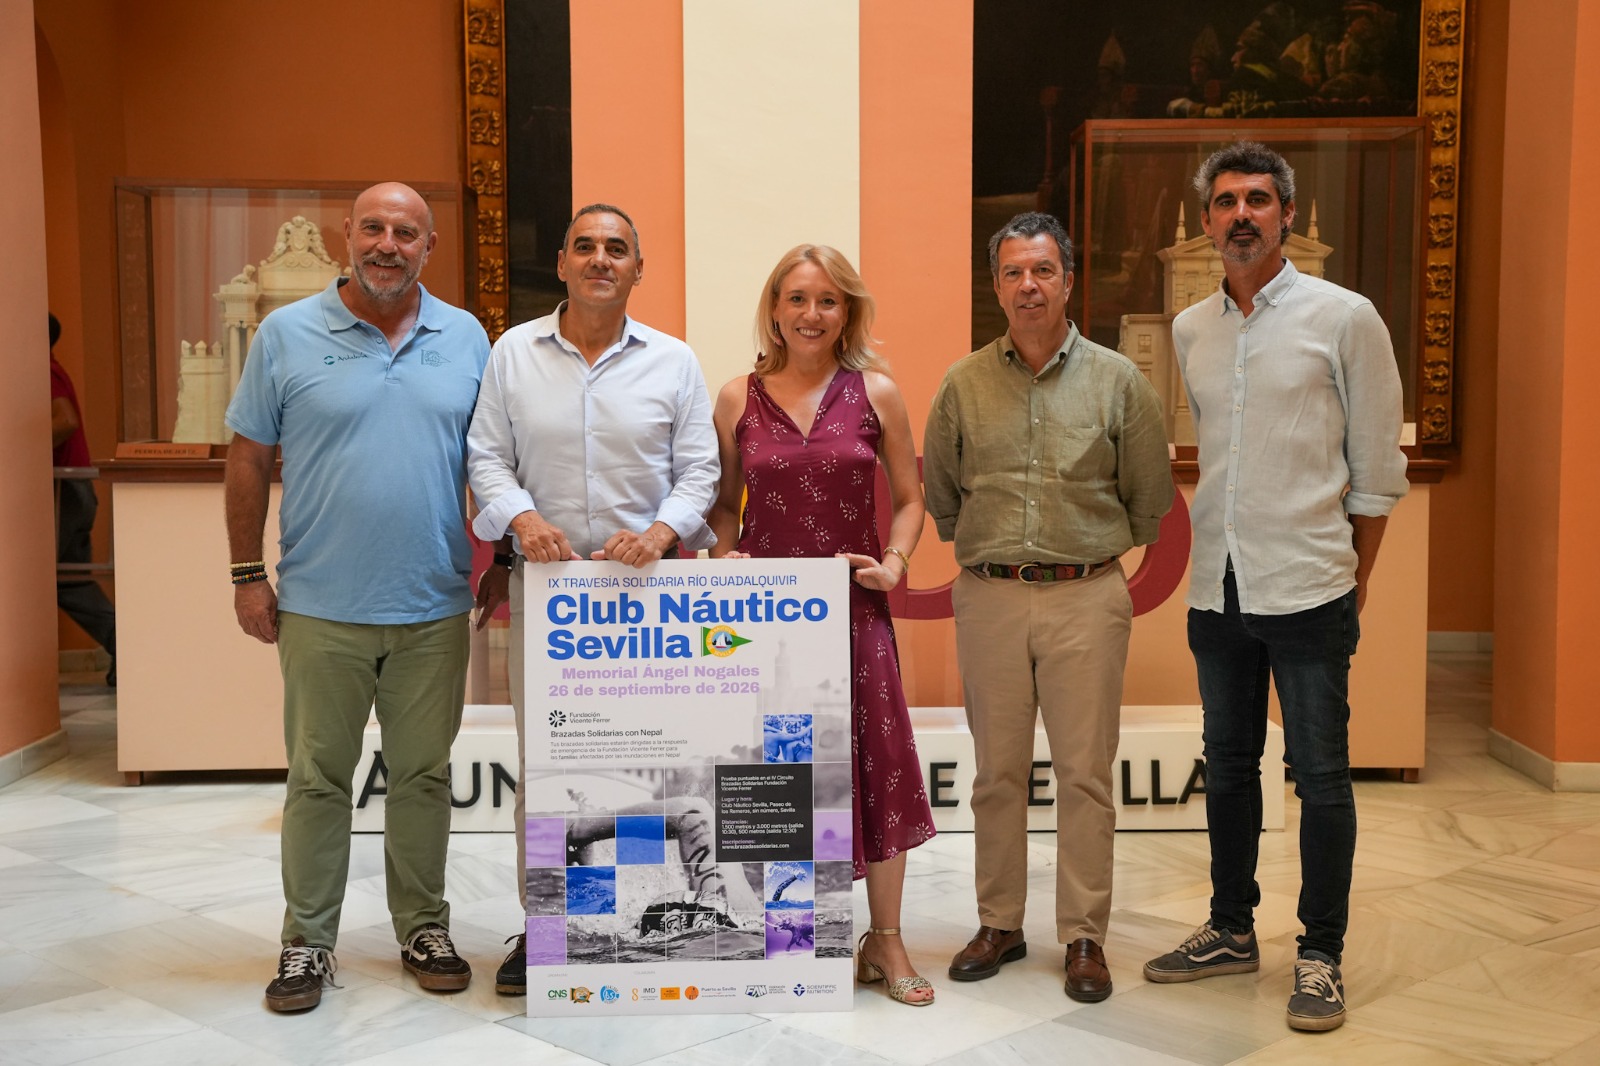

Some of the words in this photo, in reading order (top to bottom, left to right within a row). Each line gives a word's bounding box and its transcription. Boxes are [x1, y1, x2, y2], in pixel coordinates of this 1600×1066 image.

[548, 578, 560, 588] IX
[562, 575, 620, 588] TRAVESÍA
[623, 576, 684, 588] SOLIDARIA
[689, 574, 707, 587] RÍO
[711, 575, 797, 588] GUADALQUIVIR
[547, 592, 645, 625] Club
[659, 590, 829, 624] Náutico
[547, 627, 692, 661] Sevilla
[562, 666, 637, 679] Memorial
[643, 664, 688, 681] Ángel
[694, 665, 760, 680] Nogales
[548, 685, 569, 697] 26
[573, 684, 594, 696] de
[598, 683, 690, 698] septiembre
[695, 682, 715, 694] de
[720, 682, 760, 694] 2026
[550, 730, 585, 738] Brazadas
[587, 729, 623, 737] Solidarias
[640, 729, 663, 737] Nepal
[1028, 759, 1208, 807] ELLA
[548, 989, 567, 999] CNS
